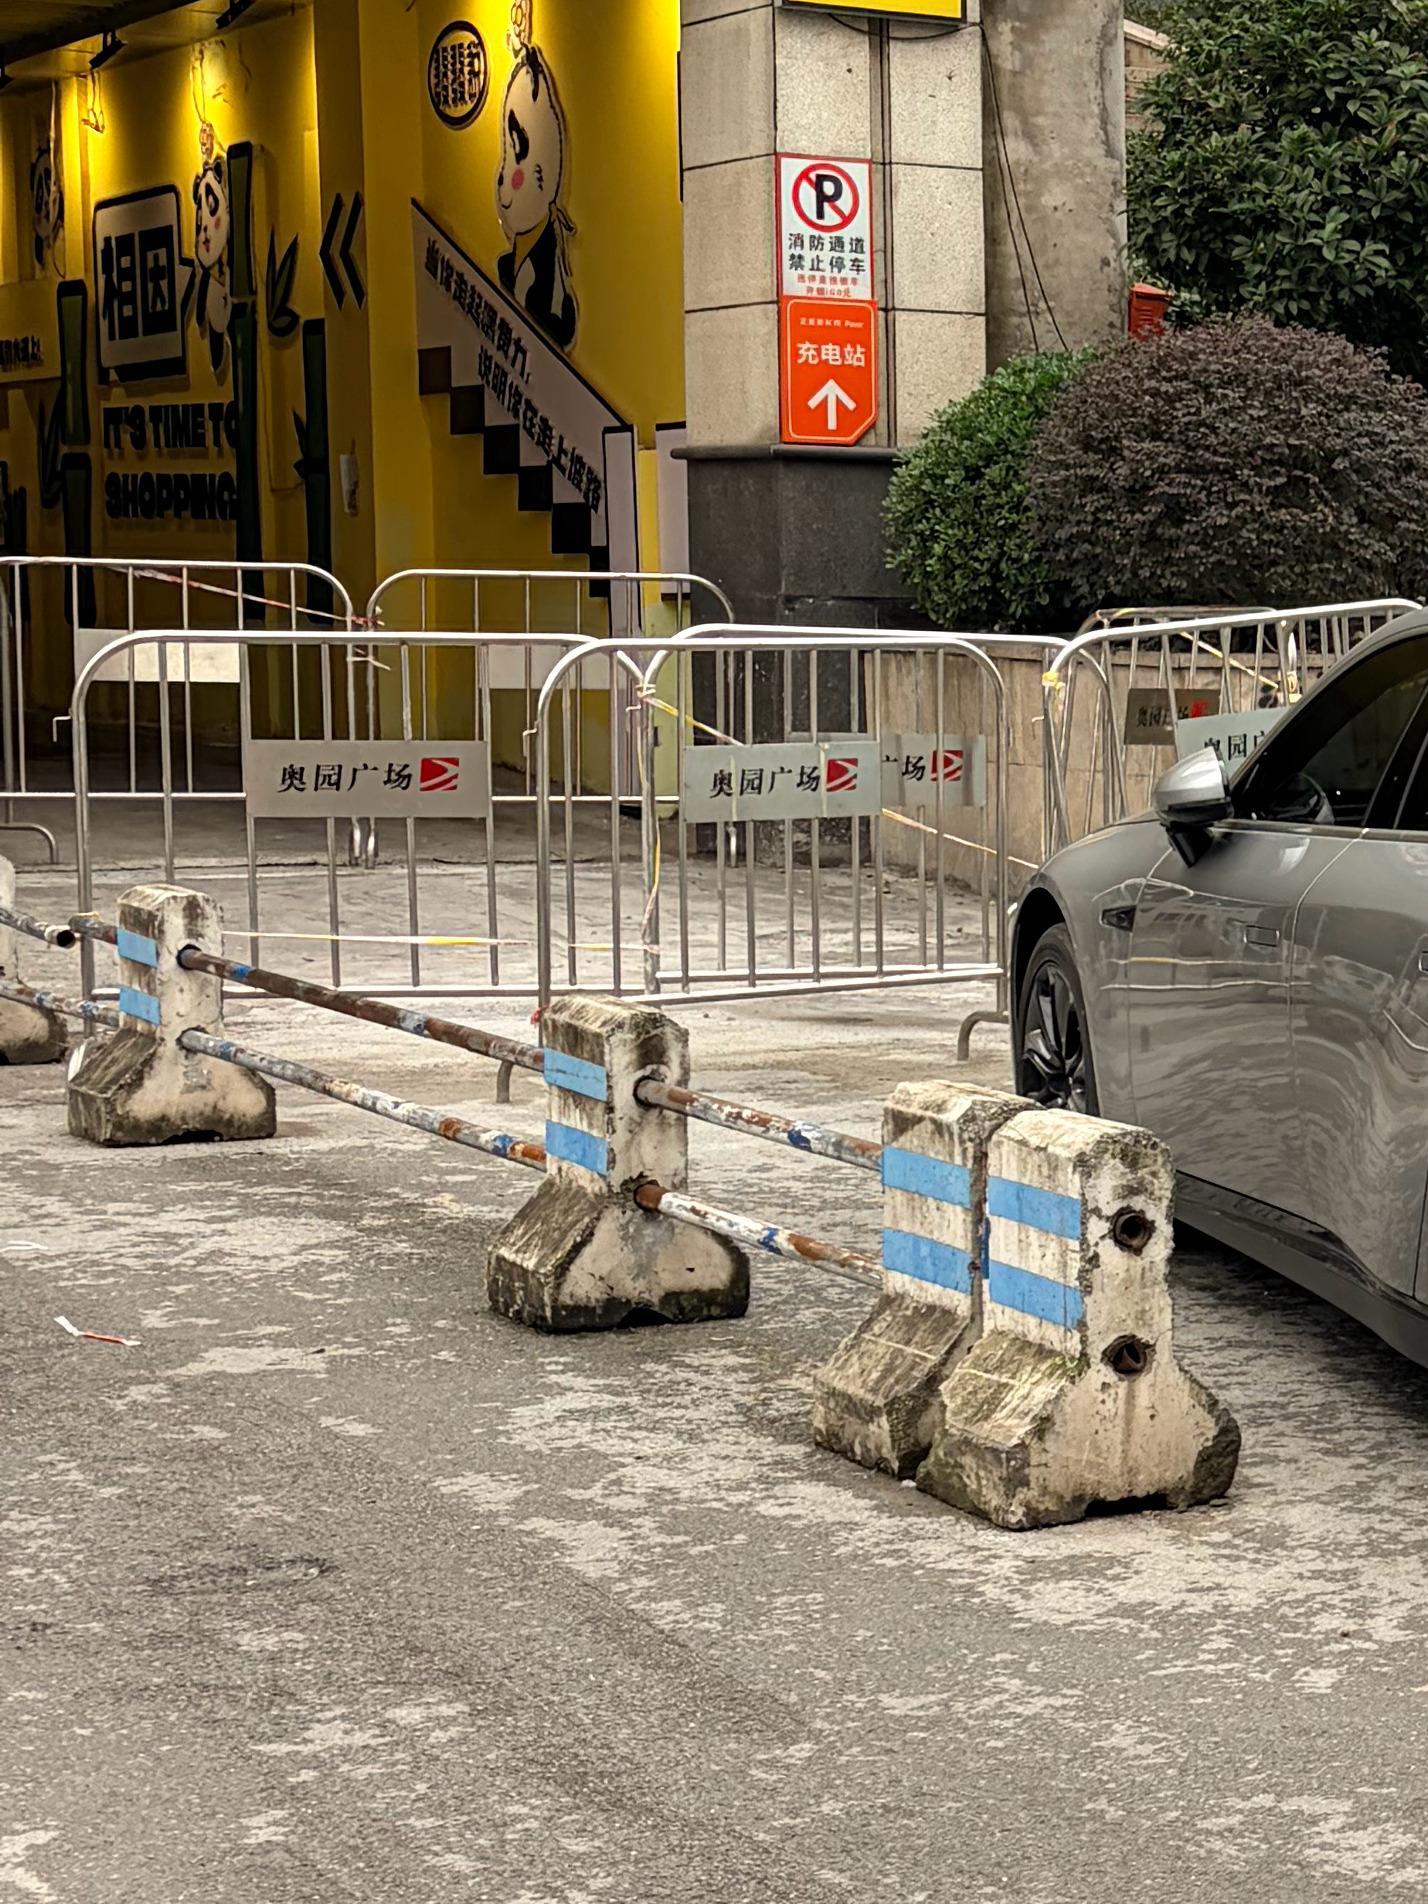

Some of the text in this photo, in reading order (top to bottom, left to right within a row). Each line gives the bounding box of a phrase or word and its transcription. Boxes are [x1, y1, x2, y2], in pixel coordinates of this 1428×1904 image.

[815, 174, 843, 221] P
[788, 233, 866, 255] 消防通道
[788, 253, 866, 275] 禁止停车
[101, 224, 178, 341] 相因
[797, 340, 866, 368] 充电站
[103, 404, 147, 450] IT'S
[149, 402, 206, 449] TIME
[278, 762, 412, 795] 奥园广场
[711, 765, 820, 798] 奥园广场
